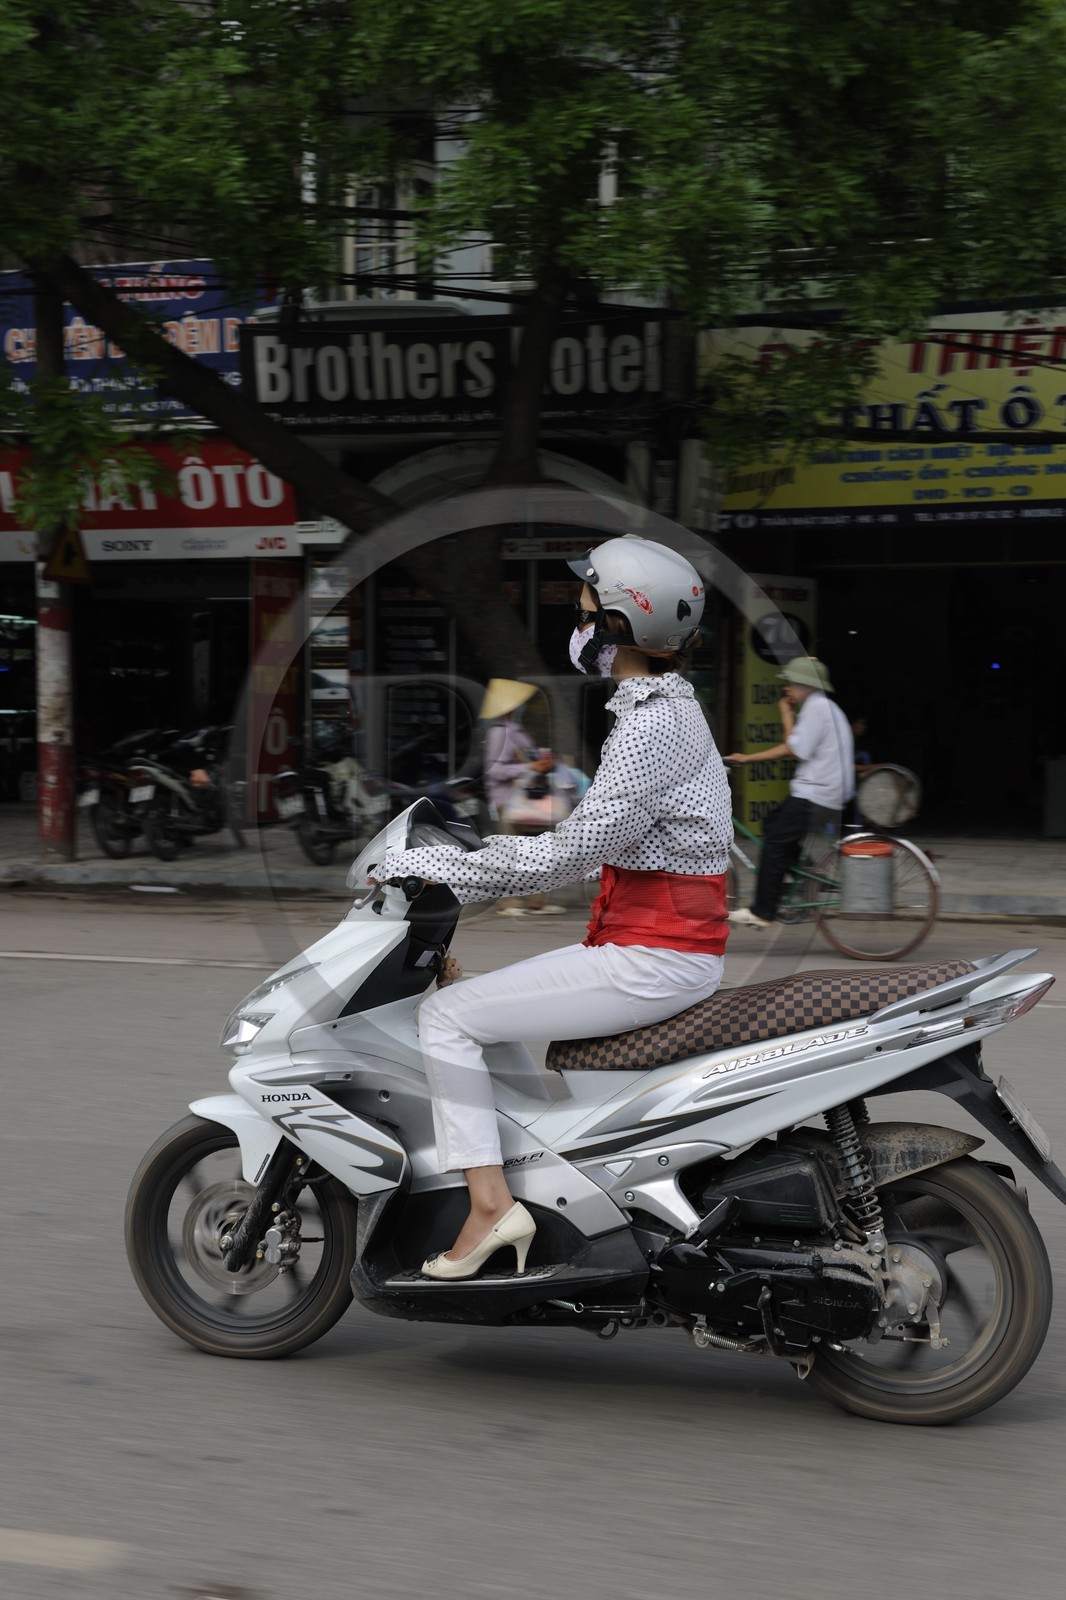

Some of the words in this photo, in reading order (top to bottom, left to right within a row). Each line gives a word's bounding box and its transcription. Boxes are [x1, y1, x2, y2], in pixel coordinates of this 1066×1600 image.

[253, 332, 496, 403] Brothers
[1001, 385, 1043, 429] Ô
[177, 457, 285, 510] ÔTÔ
[102, 540, 152, 552] SONY
[256, 537, 286, 550] JVC
[261, 1093, 312, 1103] HONDA
